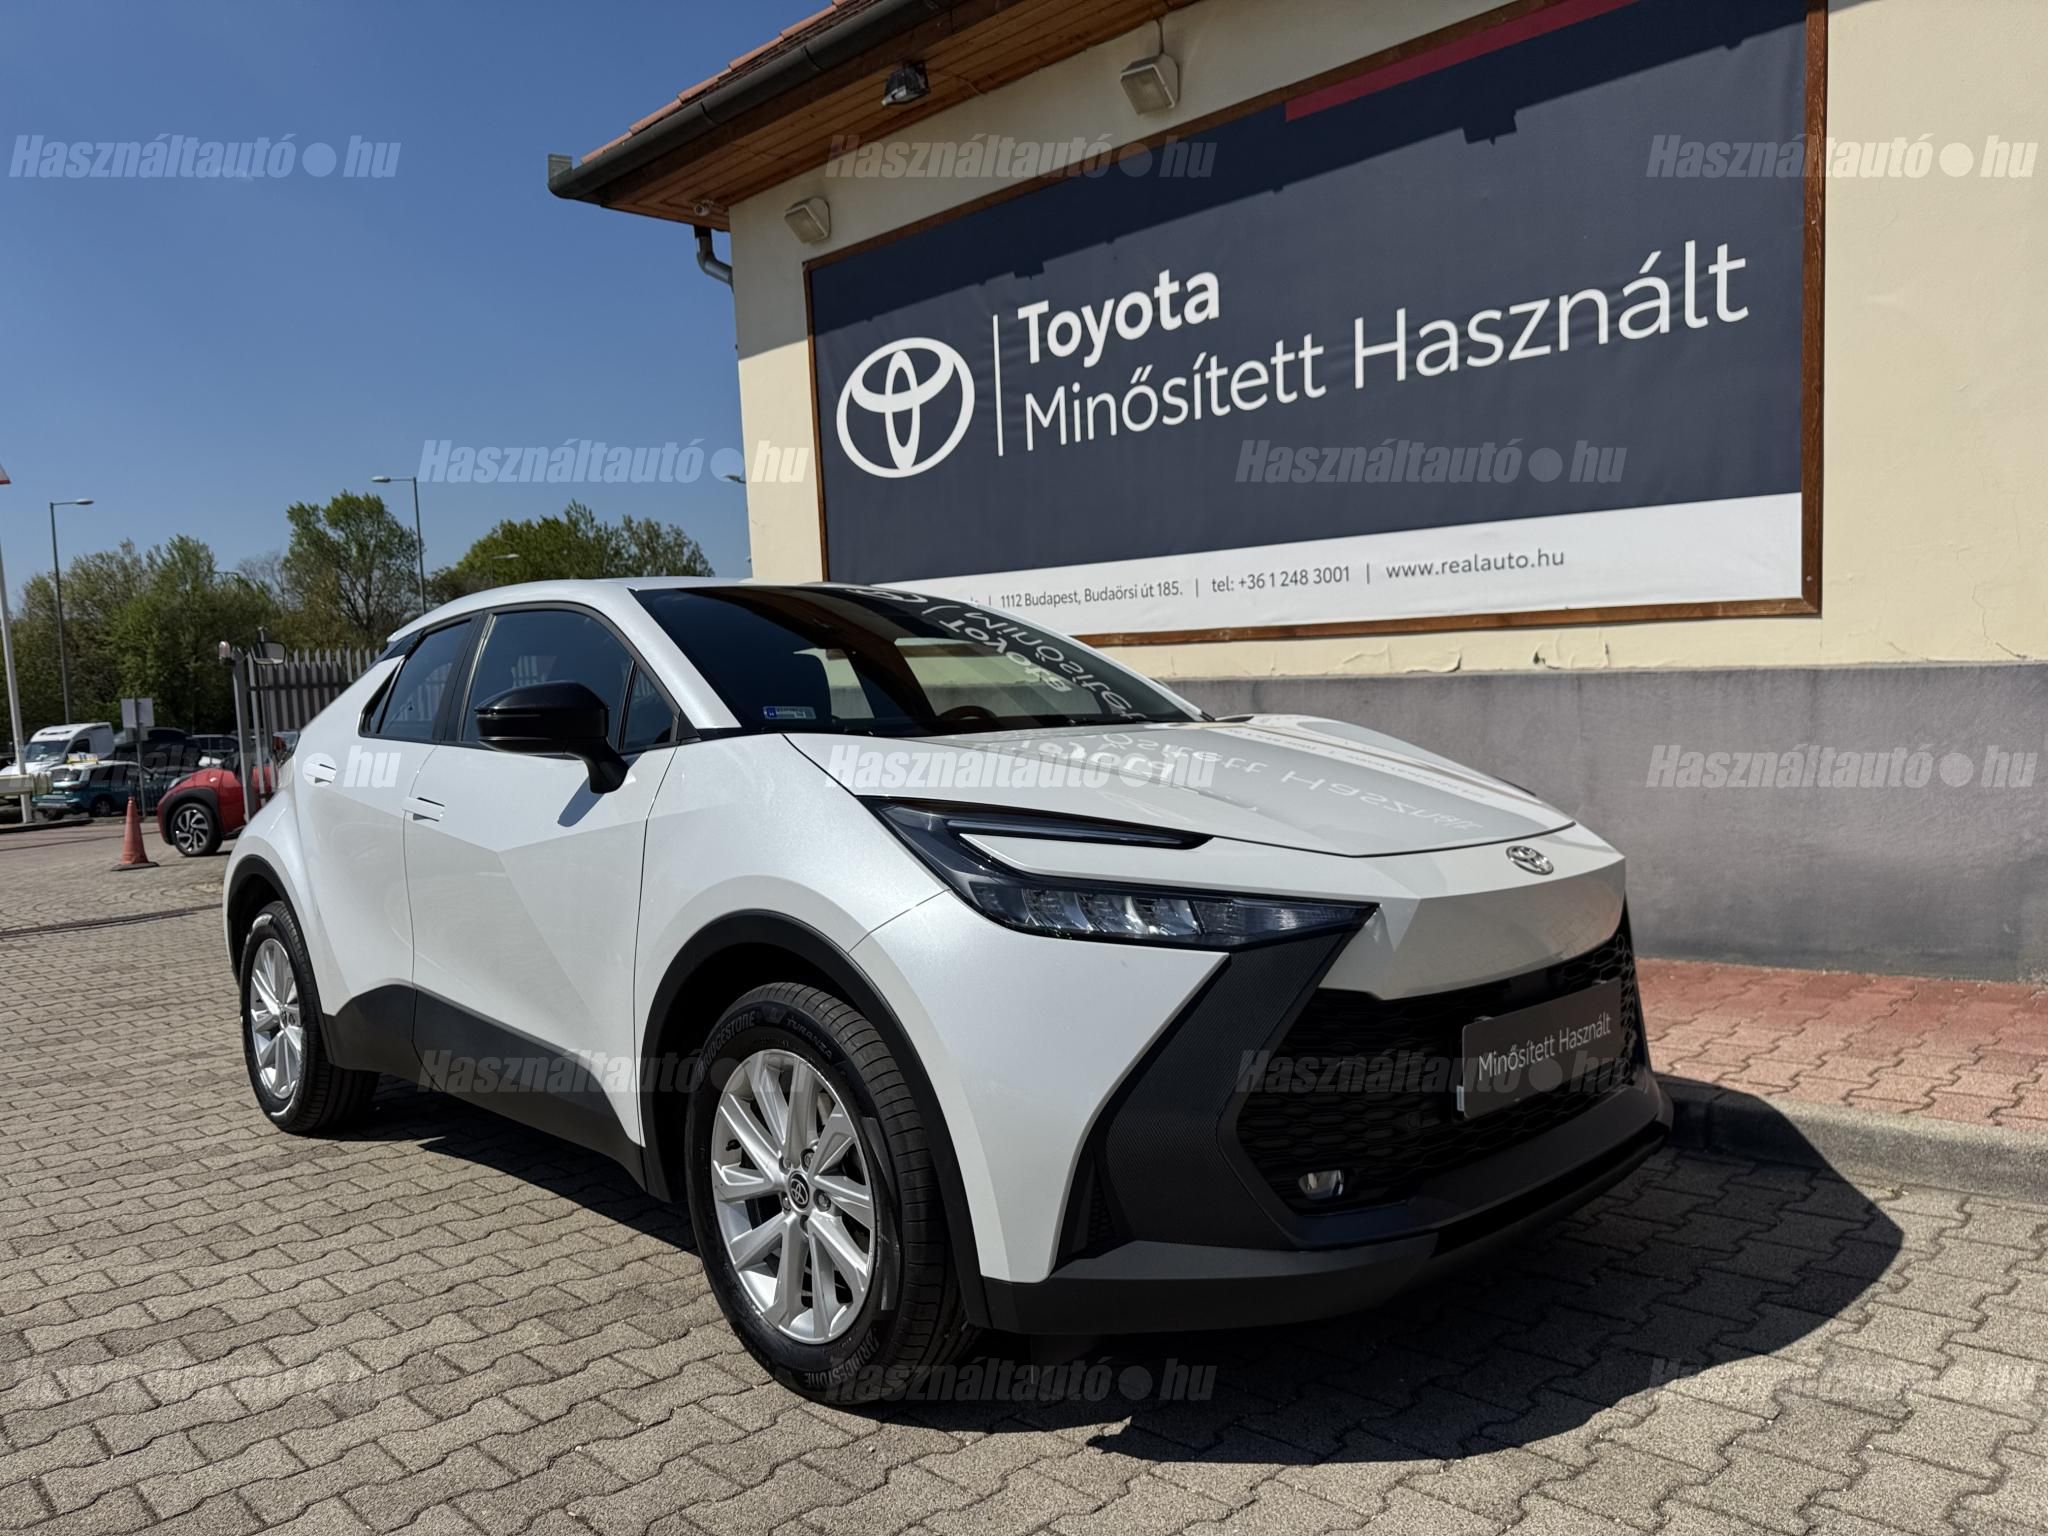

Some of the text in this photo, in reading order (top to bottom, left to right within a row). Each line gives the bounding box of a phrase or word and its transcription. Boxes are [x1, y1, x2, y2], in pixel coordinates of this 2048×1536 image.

[1017, 269, 1220, 368] Toyota
[1024, 240, 1749, 452] Minősített Használt
[1211, 576, 1234, 592] tel:
[1238, 574, 1265, 591] +36
[1280, 570, 1309, 587] 248
[1313, 566, 1350, 585] 3001
[1385, 548, 1565, 579] www.realauto.hu
[1001, 580, 1183, 609] 1112 Budapest, Budaörsi út 185.
[1478, 1010, 1612, 1081] Minősített Használt
